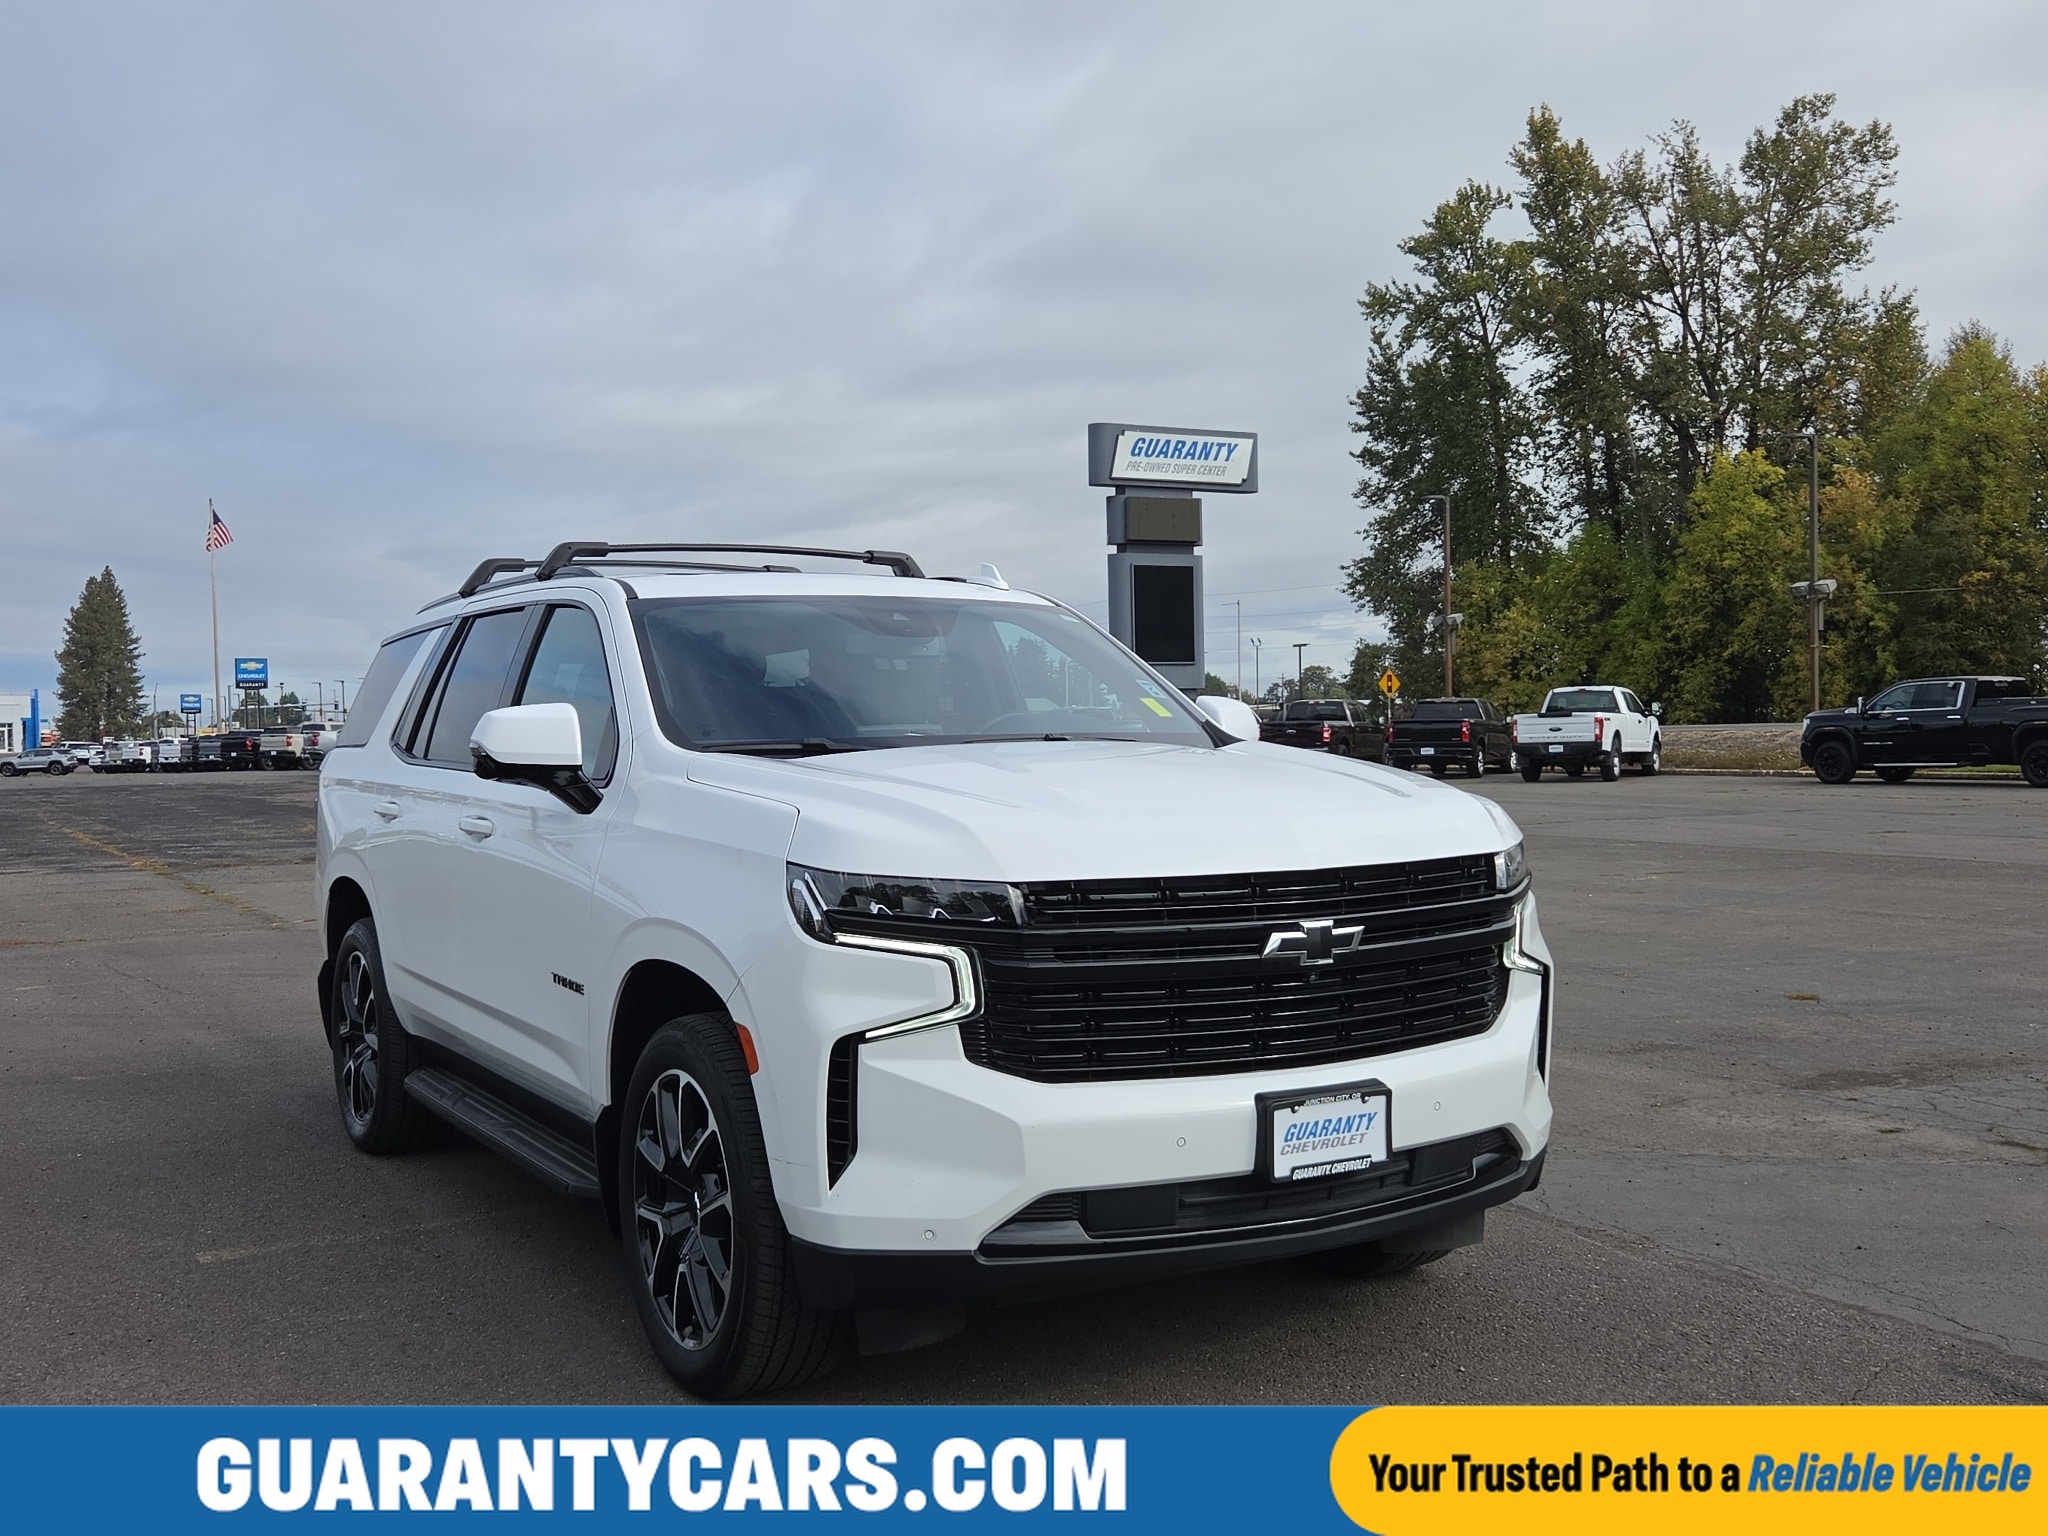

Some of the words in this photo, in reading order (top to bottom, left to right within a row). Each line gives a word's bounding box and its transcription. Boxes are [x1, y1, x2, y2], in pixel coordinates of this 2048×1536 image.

[1130, 437, 1239, 462] GUARANTY
[1125, 460, 1171, 474] PRE-OWNED
[1171, 463, 1197, 475] SUPER
[1197, 464, 1228, 477] CENTER
[551, 971, 585, 996] TAHOE
[1303, 1096, 1335, 1106] JUNCTION
[1351, 1092, 1362, 1100] OR
[1283, 1111, 1378, 1143] GUARANTY
[1280, 1132, 1368, 1156] CHEVROLET
[1331, 1157, 1372, 1174] CHEVROLET
